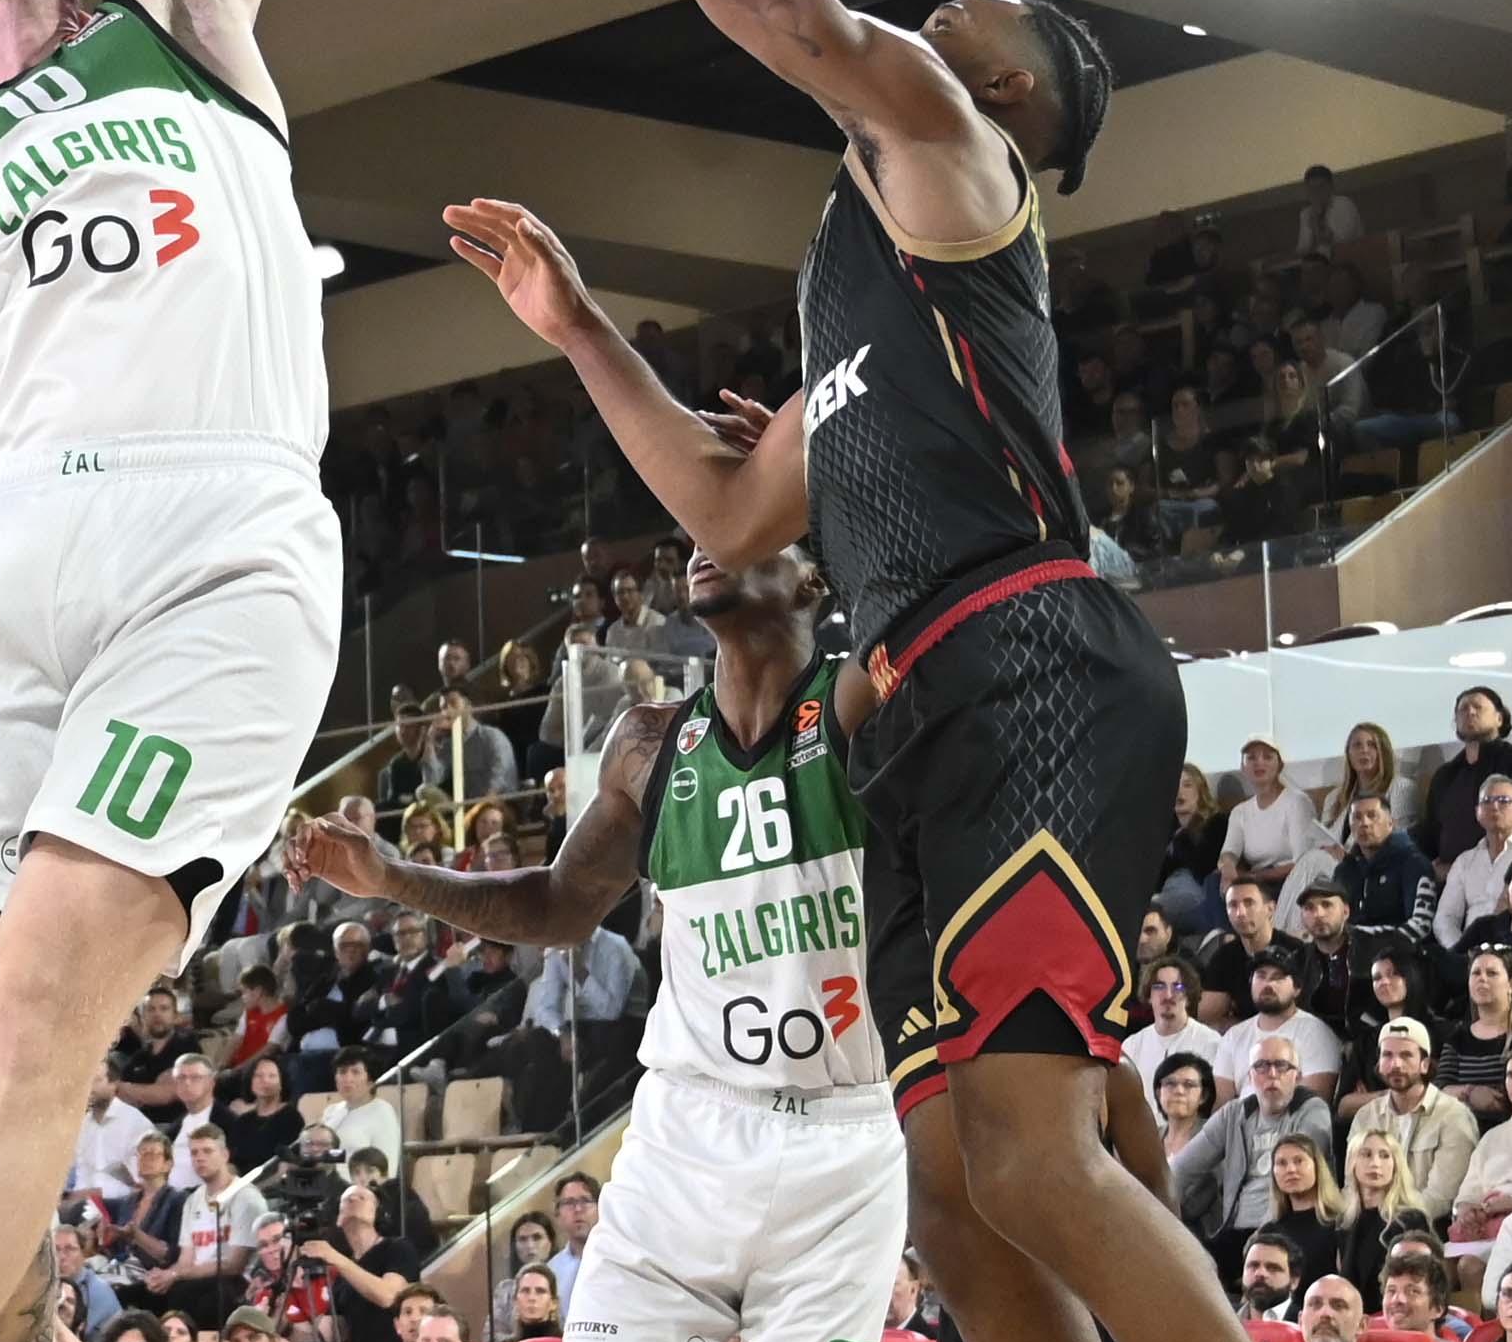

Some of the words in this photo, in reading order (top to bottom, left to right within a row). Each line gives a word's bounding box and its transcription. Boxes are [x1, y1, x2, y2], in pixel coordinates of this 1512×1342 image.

[61, 450, 106, 477] ŽAL
[76, 719, 193, 841] 10
[717, 776, 793, 872] 26
[772, 1090, 809, 1116] ŽAL
